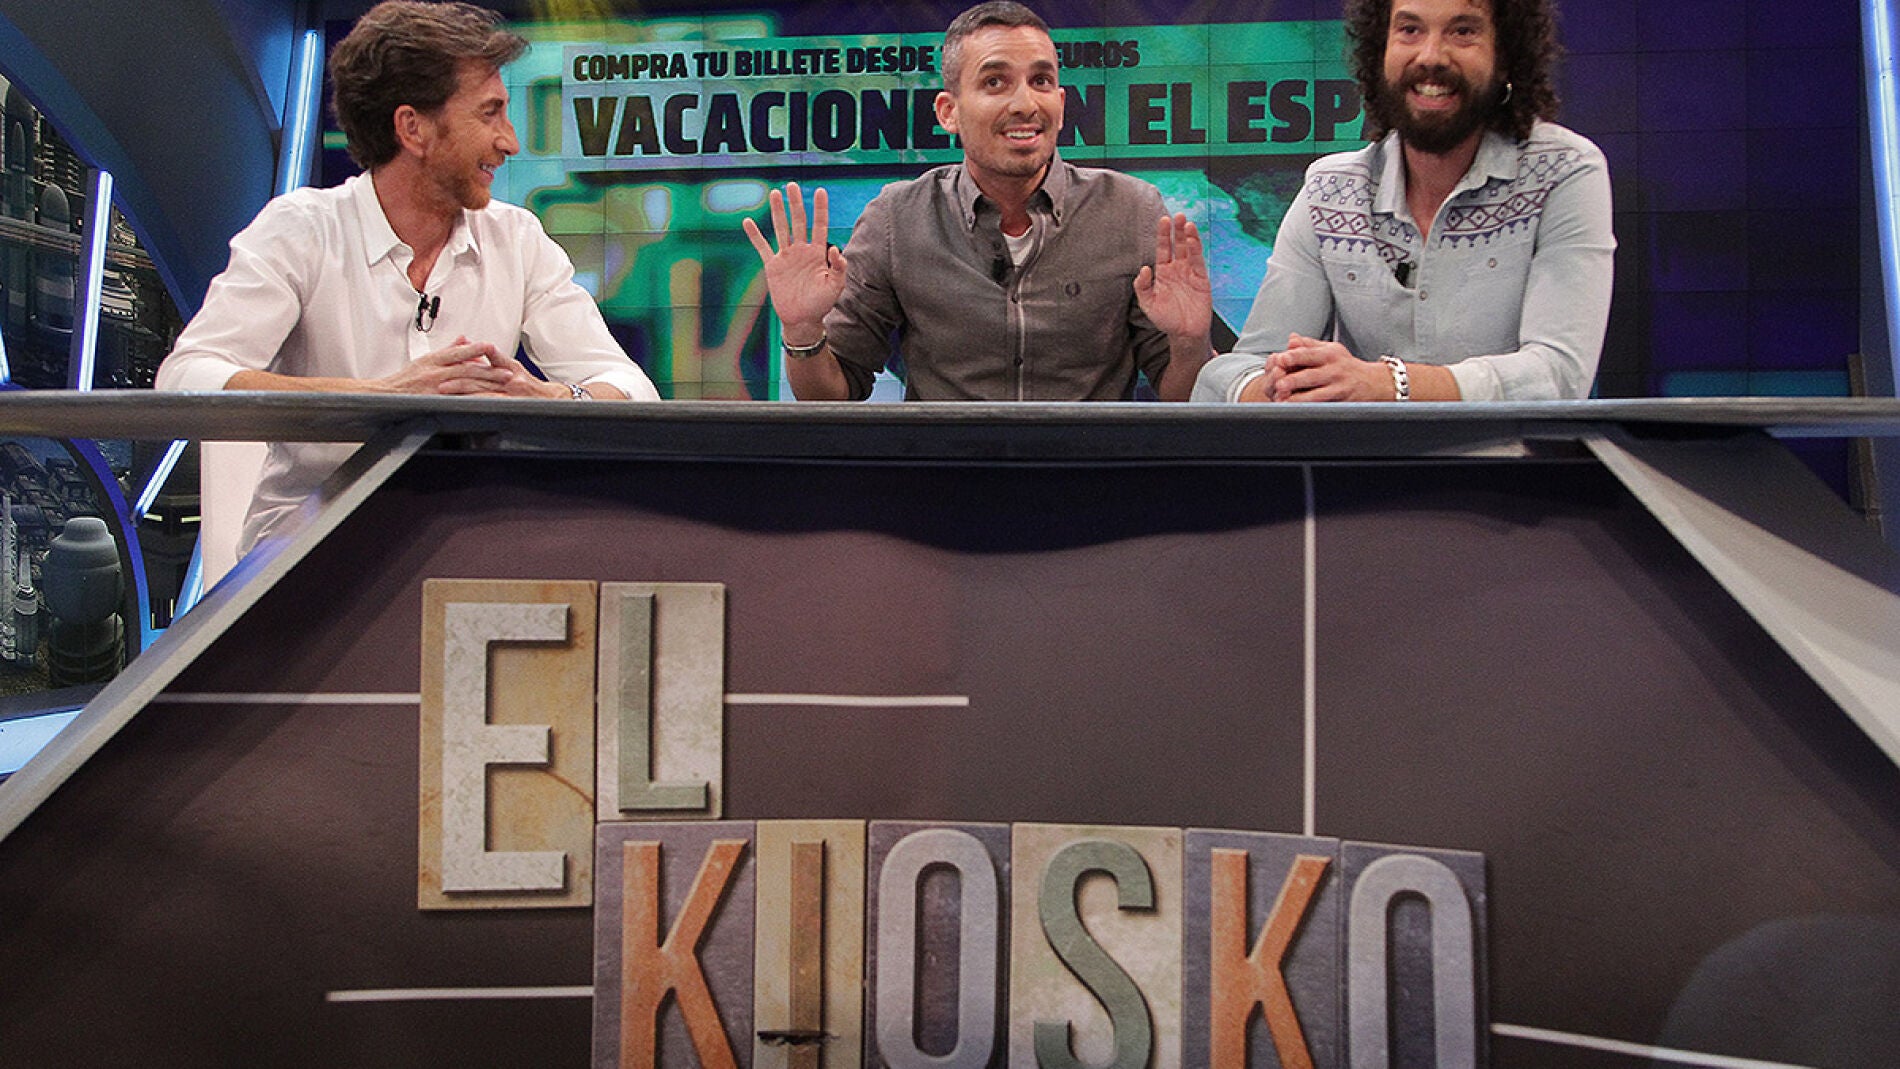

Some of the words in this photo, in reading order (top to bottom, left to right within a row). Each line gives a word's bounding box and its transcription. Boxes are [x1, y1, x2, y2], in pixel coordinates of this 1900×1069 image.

[573, 53, 689, 82] COMPRA
[692, 51, 728, 78] TU
[735, 47, 841, 77] BILLETE
[846, 45, 935, 74] DESDE
[573, 88, 965, 157] VACACIONE
[1128, 83, 1206, 145] EL
[441, 593, 711, 895] EL
[618, 828, 1476, 1069] KIOSKO
